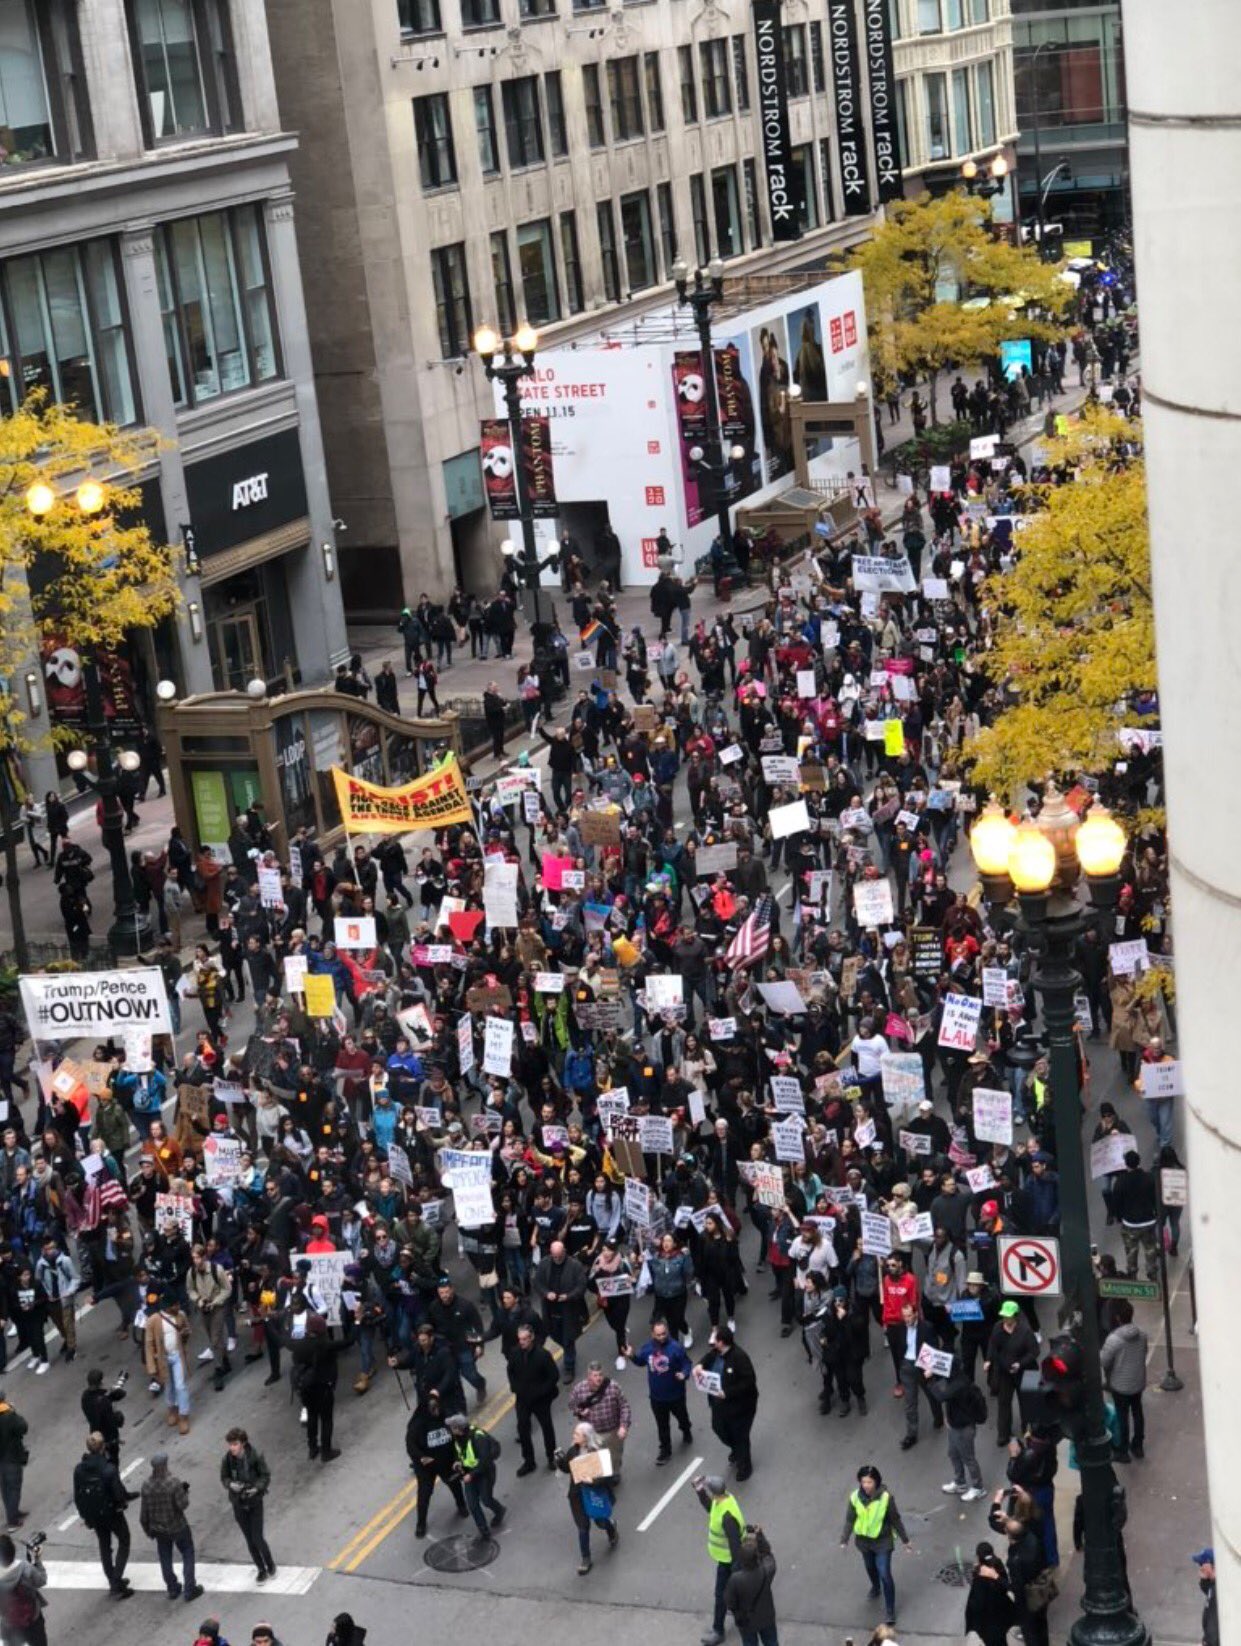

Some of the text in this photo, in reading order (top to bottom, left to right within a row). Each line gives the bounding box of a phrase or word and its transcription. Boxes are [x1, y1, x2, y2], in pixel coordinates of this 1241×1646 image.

[831, 4, 865, 195] NORDSTROM rack
[867, 0, 899, 185] NORDSTROM rack
[756, 19, 794, 221] NORDSTROM rack
[555, 383, 606, 398] STREET
[519, 406, 575, 418] PEN 11.15
[232, 472, 269, 511] AT&T
[44, 980, 147, 1000] Trump/Pence
[38, 997, 160, 1024] #OUTNOW!
